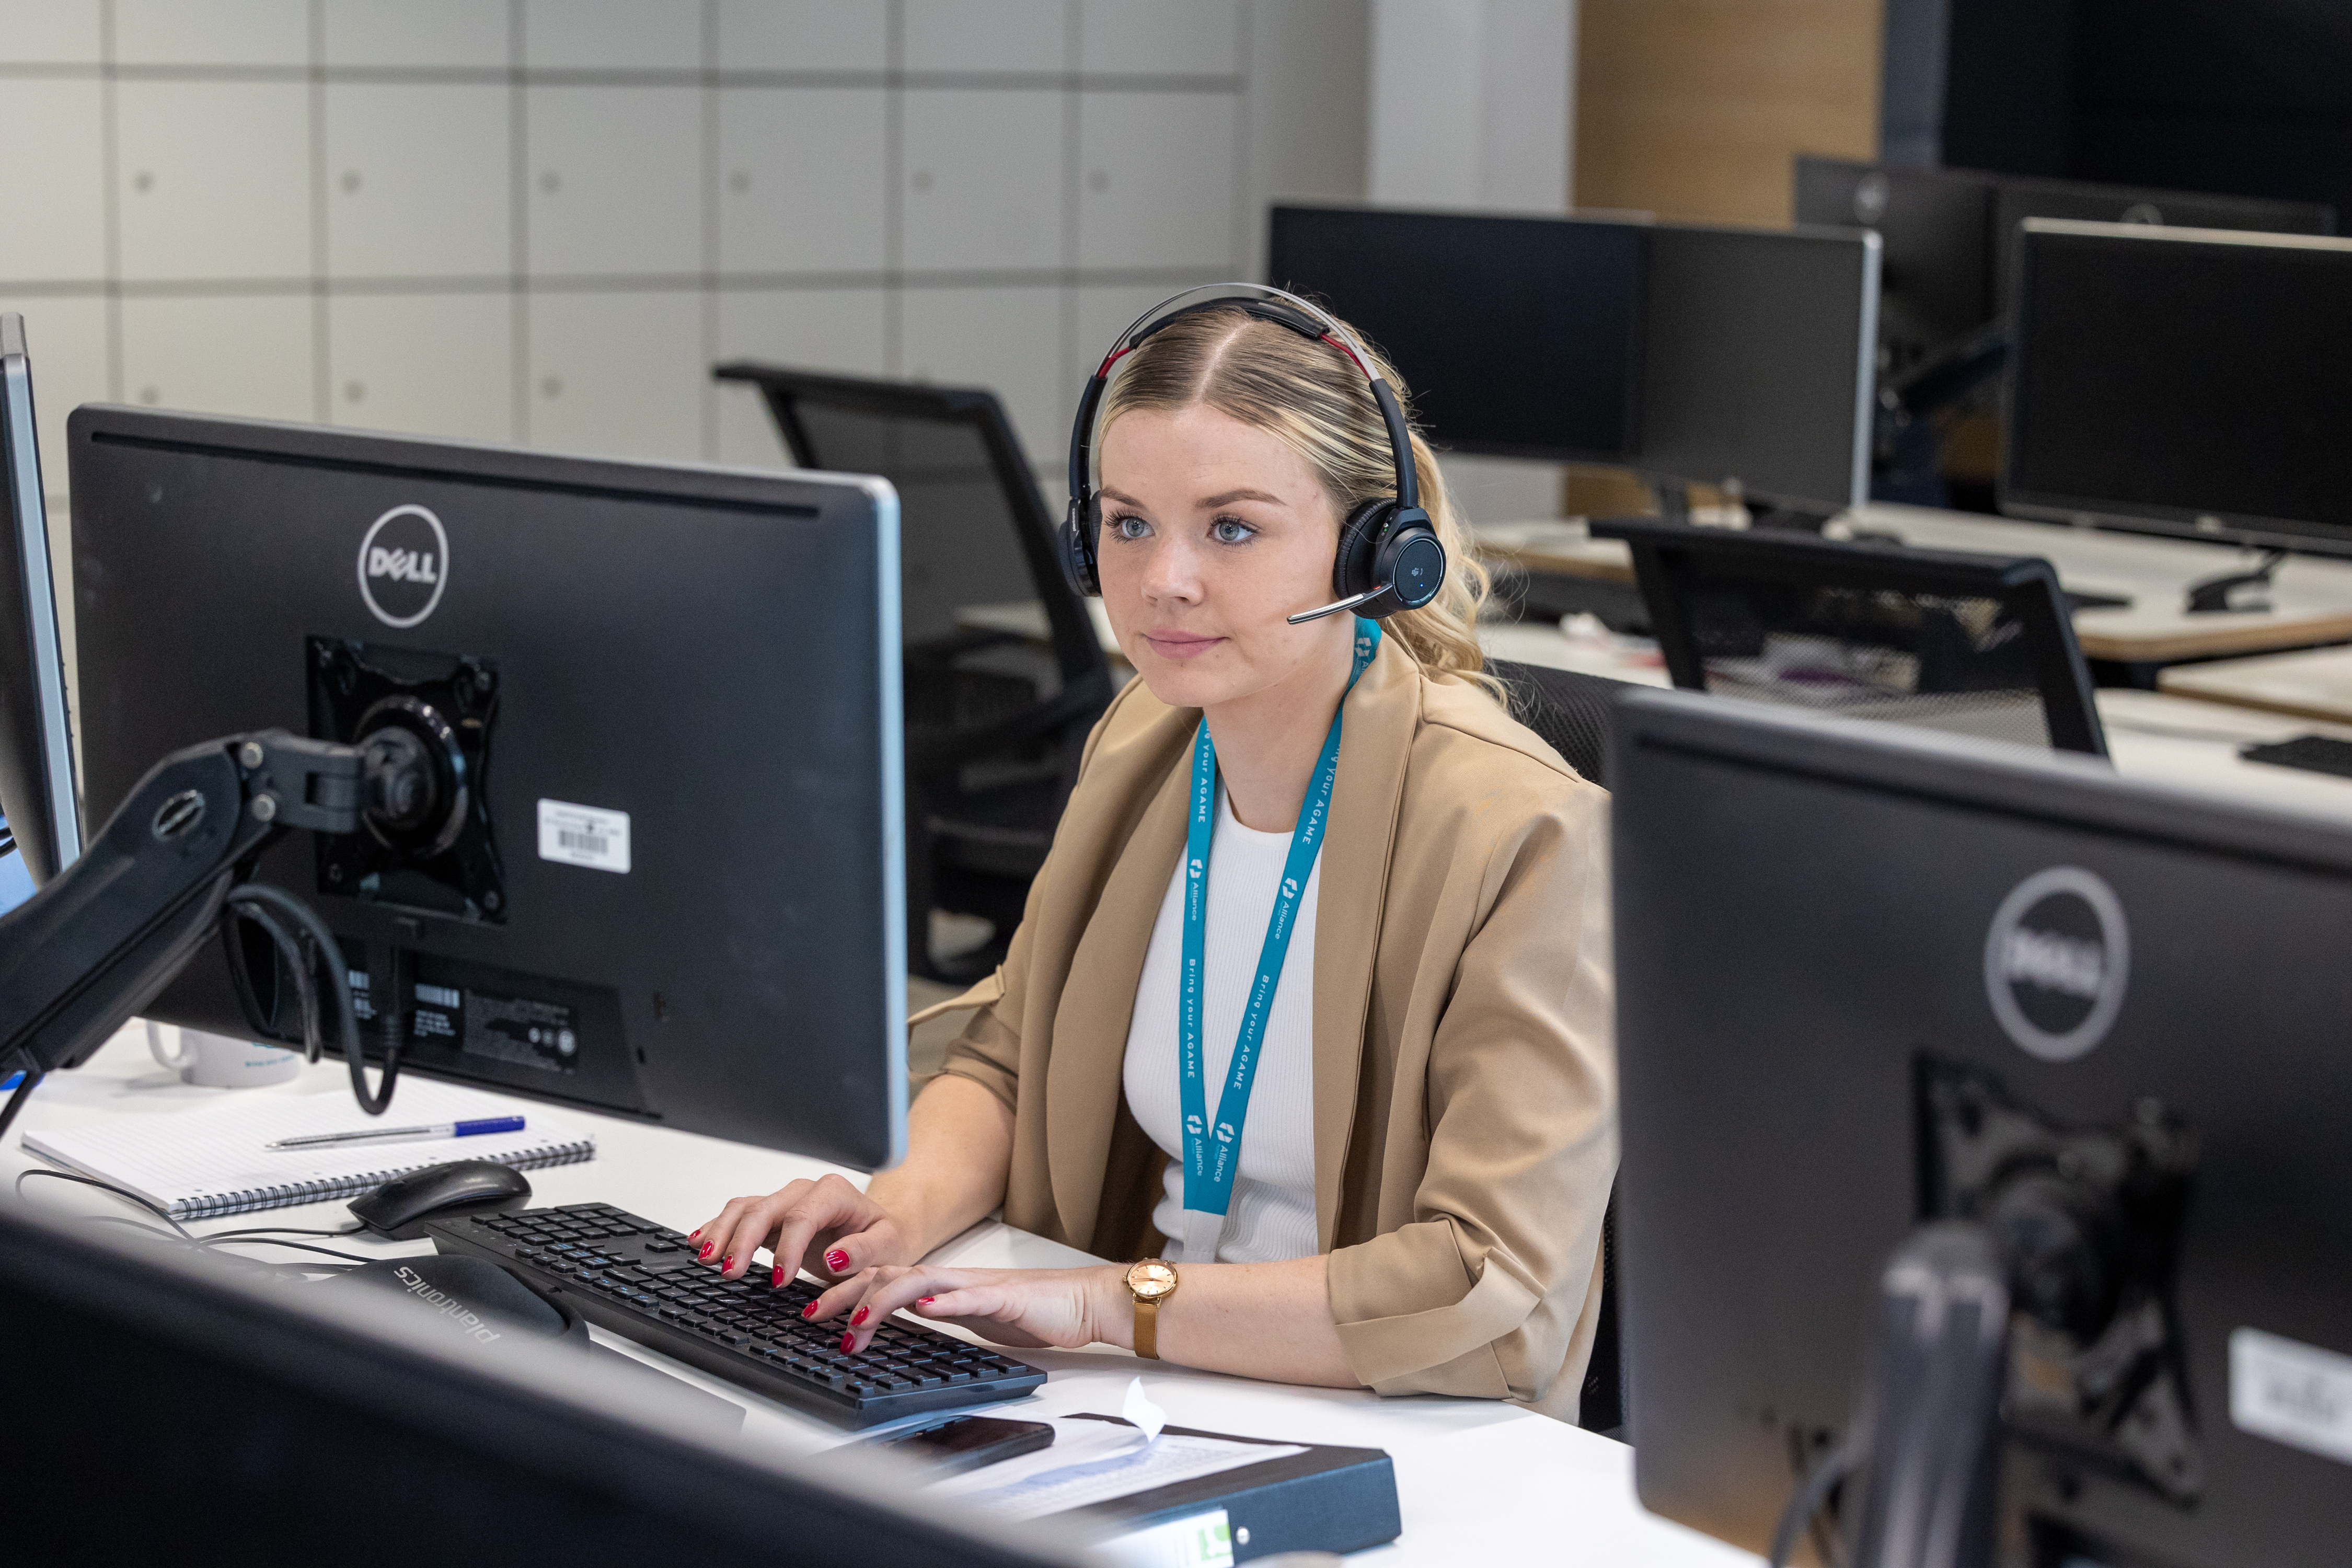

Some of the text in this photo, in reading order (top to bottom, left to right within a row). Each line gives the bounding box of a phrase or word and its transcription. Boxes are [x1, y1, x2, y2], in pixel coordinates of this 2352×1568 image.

[368, 547, 436, 583] DELL
[1198, 777, 1208, 822] AGAME
[1321, 767, 1336, 795] your
[1302, 799, 1324, 844] AGAME
[1275, 901, 1289, 939] Alliance
[1187, 959, 1195, 993] Bring
[1233, 975, 1270, 1089] Bring your AGAME
[1194, 1138, 1203, 1176] Alliance
[1214, 1145, 1228, 1182] Alliance
[394, 1266, 501, 1344] plantronics
